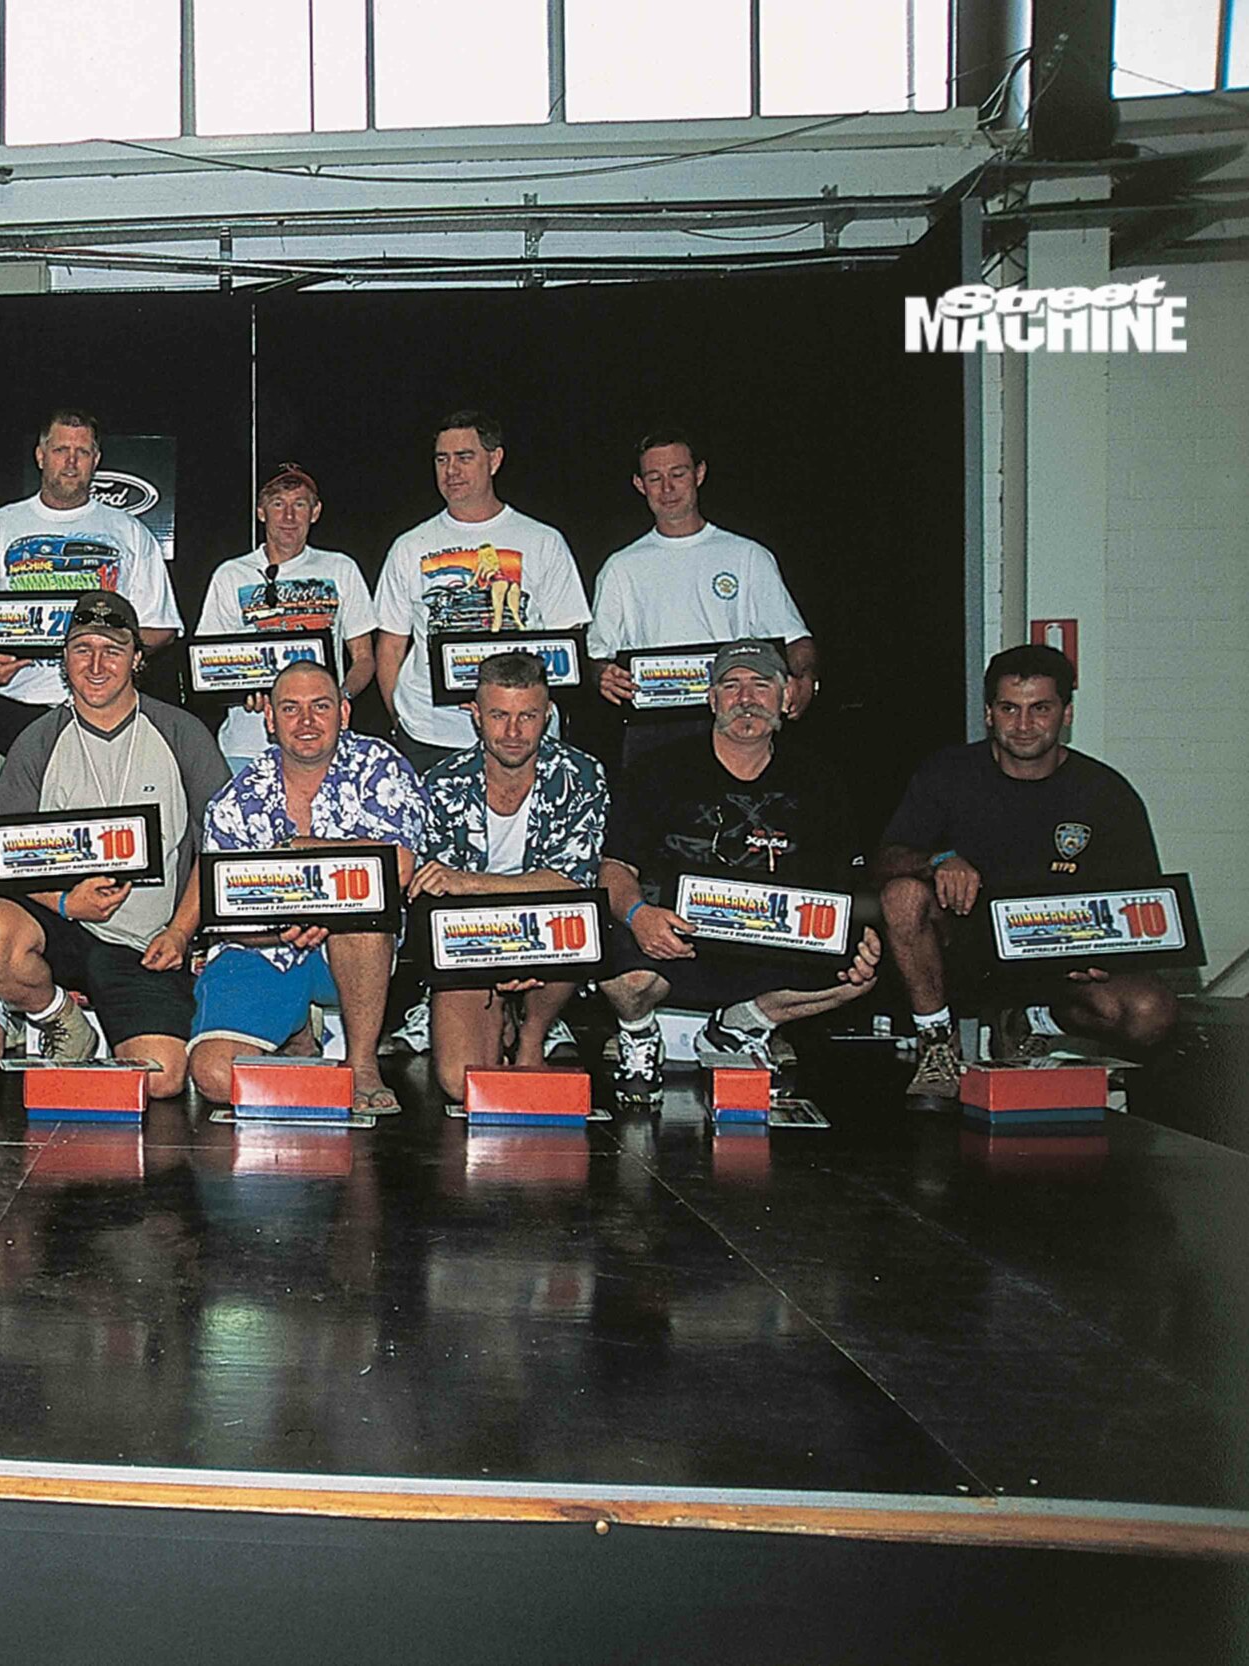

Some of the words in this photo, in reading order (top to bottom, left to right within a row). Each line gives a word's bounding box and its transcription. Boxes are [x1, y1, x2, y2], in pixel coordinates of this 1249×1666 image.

[3, 834, 75, 852] SUMMERNATS
[98, 828, 136, 860] 10
[226, 872, 305, 889] SUMMERNATS
[329, 868, 370, 901] 10
[689, 891, 769, 914] SUMMERNATS
[443, 920, 523, 939] SUMMERNATS
[795, 904, 837, 939] 10
[1006, 908, 1094, 929] SUMMERNATS
[1119, 902, 1168, 938] 10
[546, 915, 587, 951] 10
